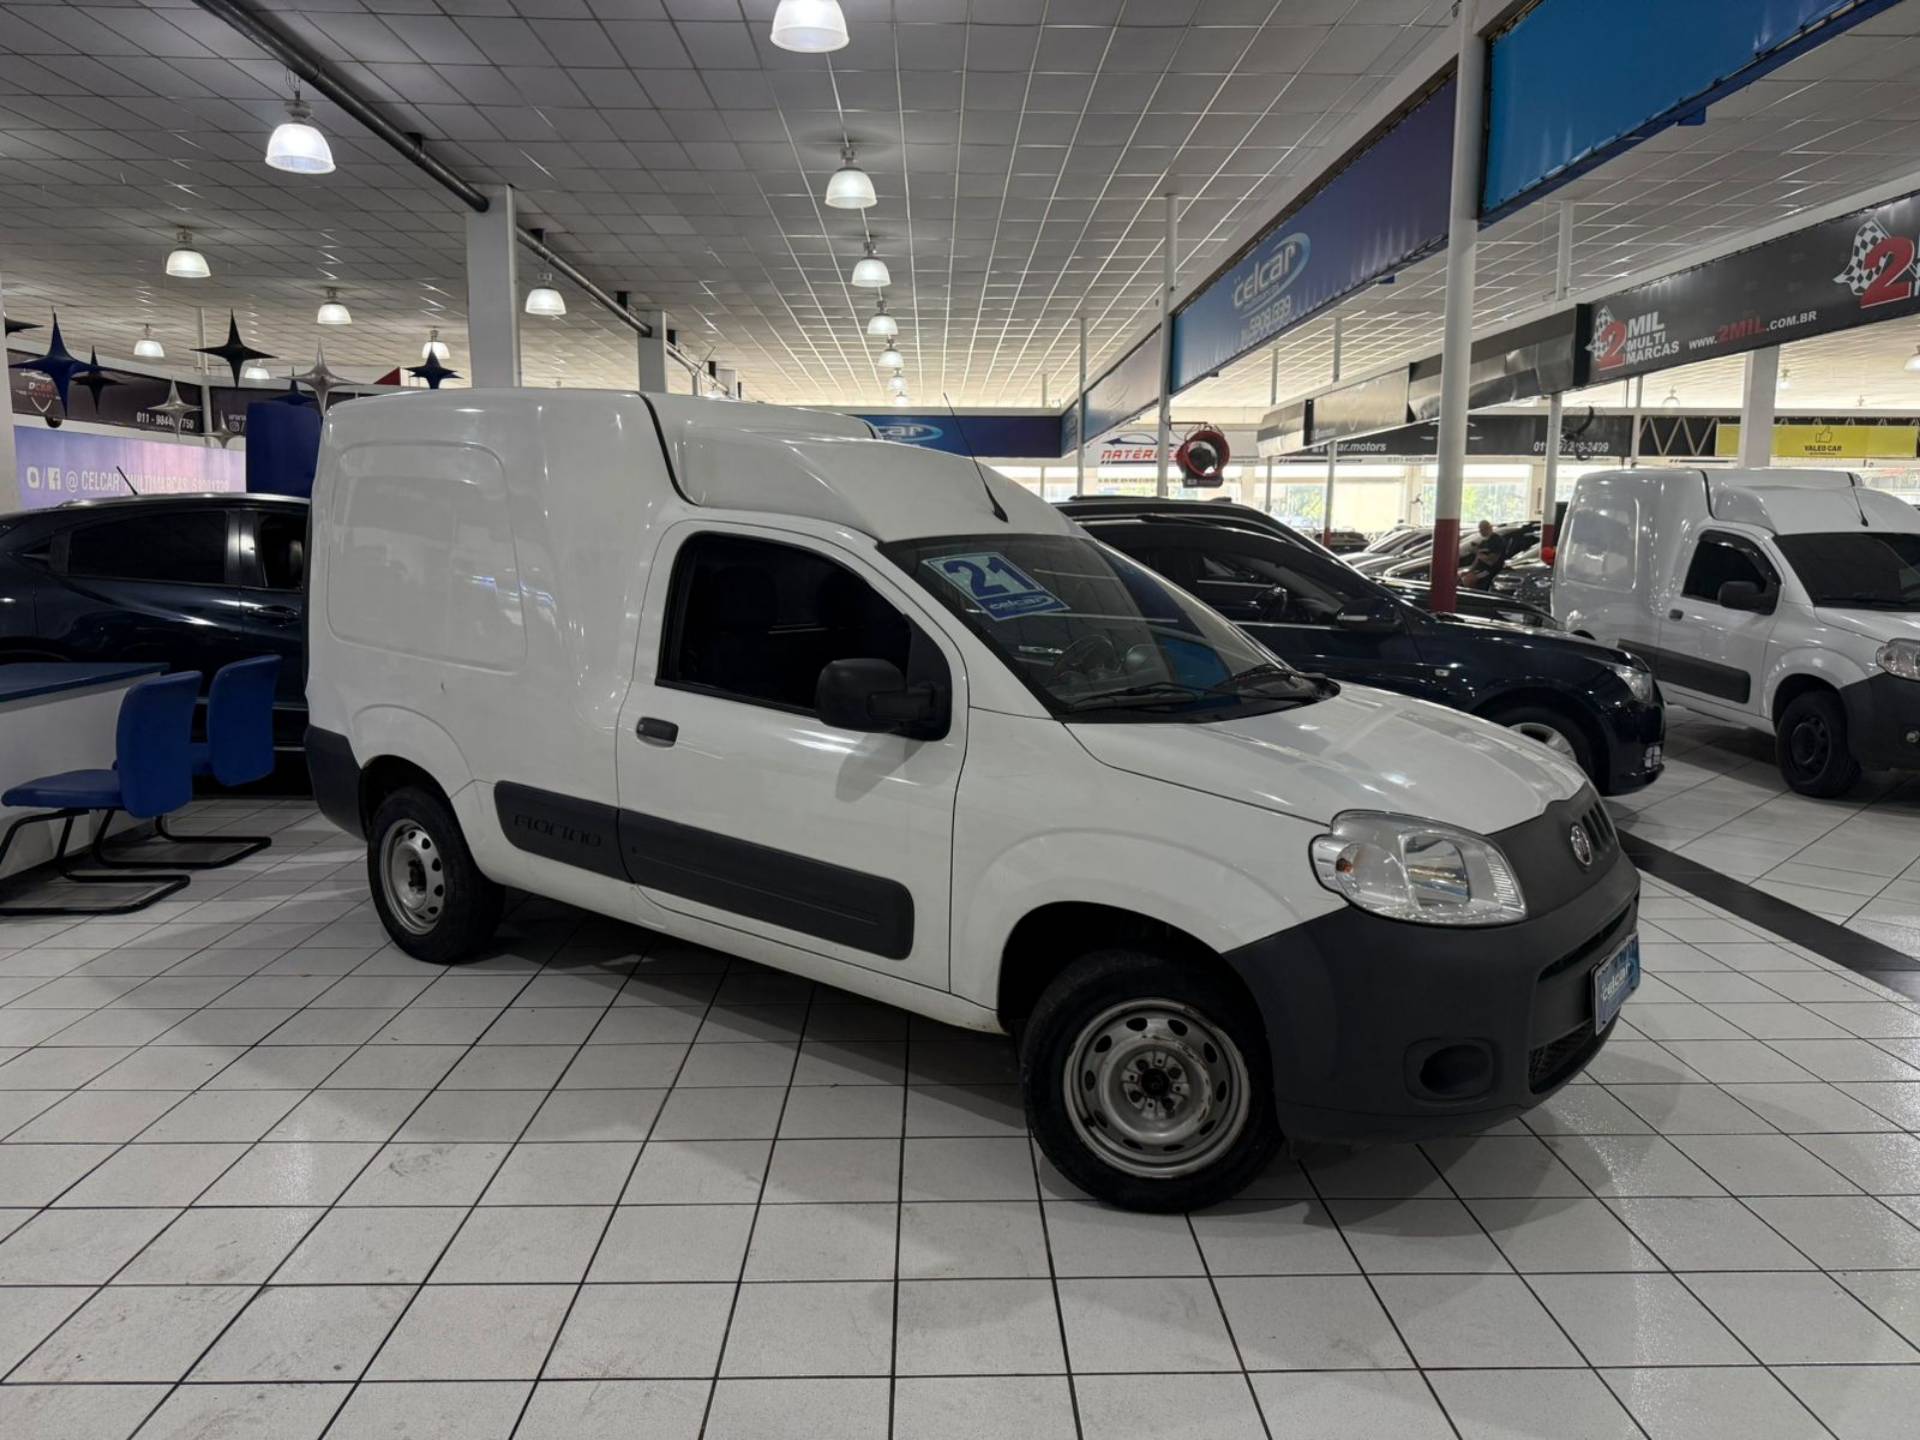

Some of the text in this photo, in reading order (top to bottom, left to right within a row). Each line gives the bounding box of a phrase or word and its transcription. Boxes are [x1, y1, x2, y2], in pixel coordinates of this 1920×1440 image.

[1859, 235, 1915, 309] 2
[1596, 311, 1665, 371] 2 MIL
[1625, 341, 1680, 366] MARCAS
[1627, 331, 1667, 352] MULTI
[943, 557, 1038, 596] 21
